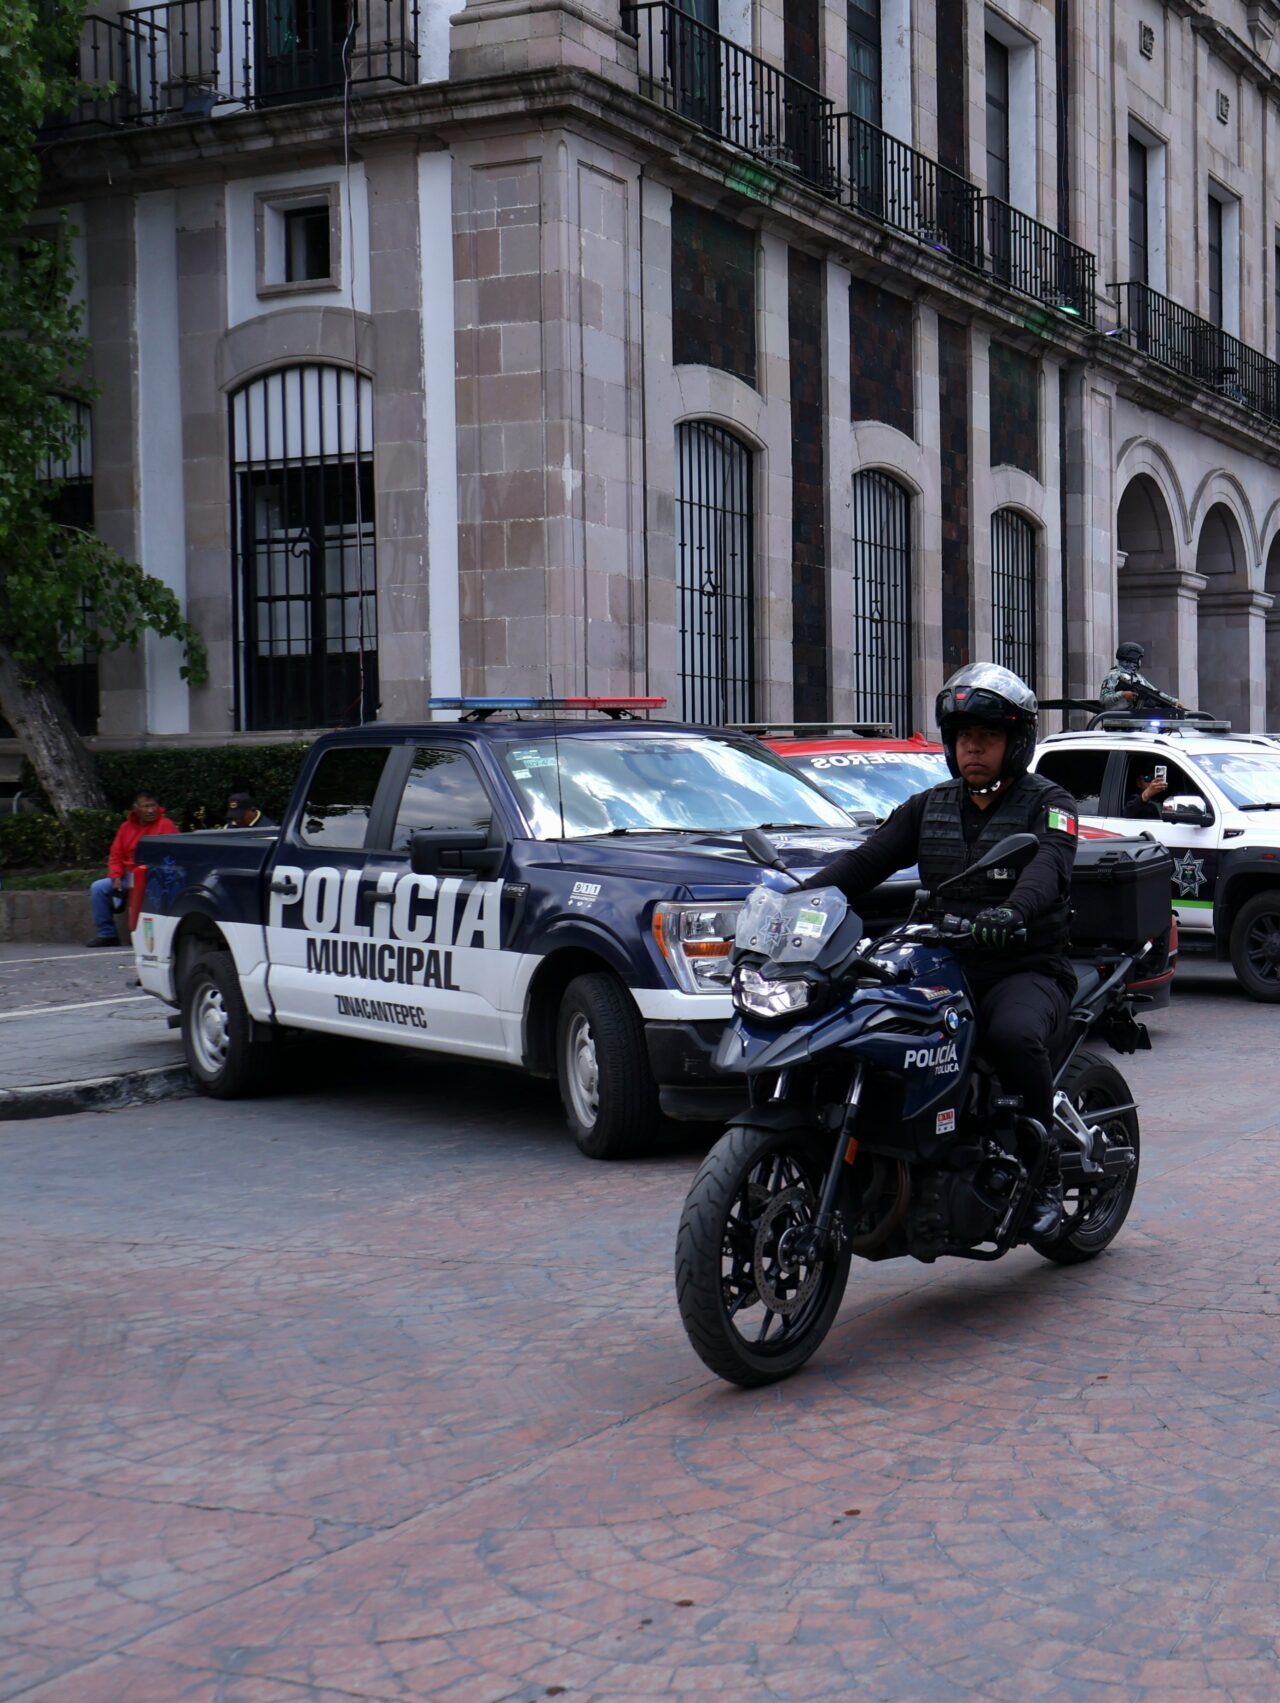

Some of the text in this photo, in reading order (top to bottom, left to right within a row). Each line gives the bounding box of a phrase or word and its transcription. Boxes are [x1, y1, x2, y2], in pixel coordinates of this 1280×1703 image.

[575, 882, 600, 894] 911
[306, 937, 460, 991] MUNICIPAL
[334, 994, 427, 1029] ZINACANTEPEC
[904, 1040, 958, 1069] POLICÍA
